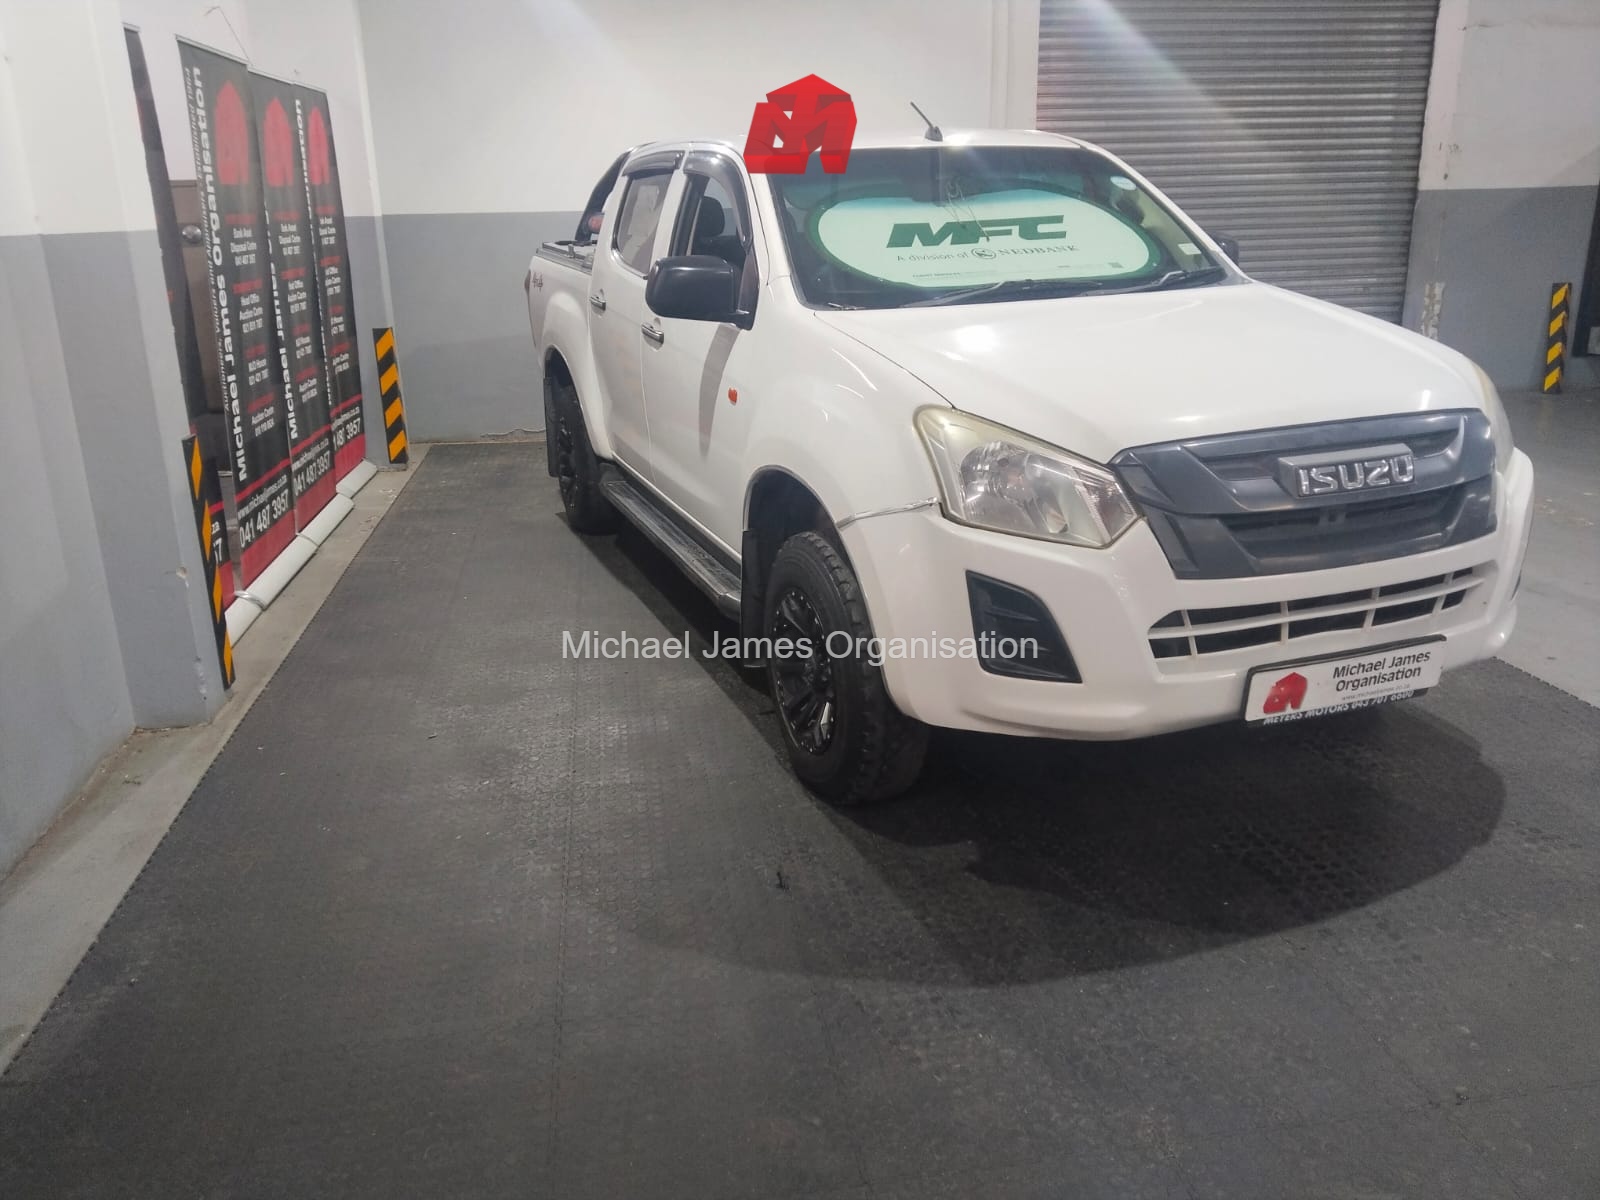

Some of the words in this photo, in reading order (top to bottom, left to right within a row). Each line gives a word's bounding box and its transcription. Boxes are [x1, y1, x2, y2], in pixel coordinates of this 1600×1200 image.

[192, 66, 222, 266] Organisation
[886, 215, 1067, 248] MFC
[908, 253, 953, 262] division
[956, 252, 968, 260] of
[998, 244, 1079, 257] NEDBANK
[216, 274, 235, 366] James
[279, 347, 298, 440] Michael
[227, 374, 247, 482] Michael
[346, 417, 360, 440] 3957
[306, 462, 317, 485] 487
[1299, 455, 1413, 495] ISUZU
[240, 518, 255, 548] 041
[256, 503, 270, 532] 487
[271, 489, 288, 519] 3957
[1333, 658, 1386, 679] Michael
[1388, 651, 1431, 669] James
[1336, 667, 1421, 692] Organisation
